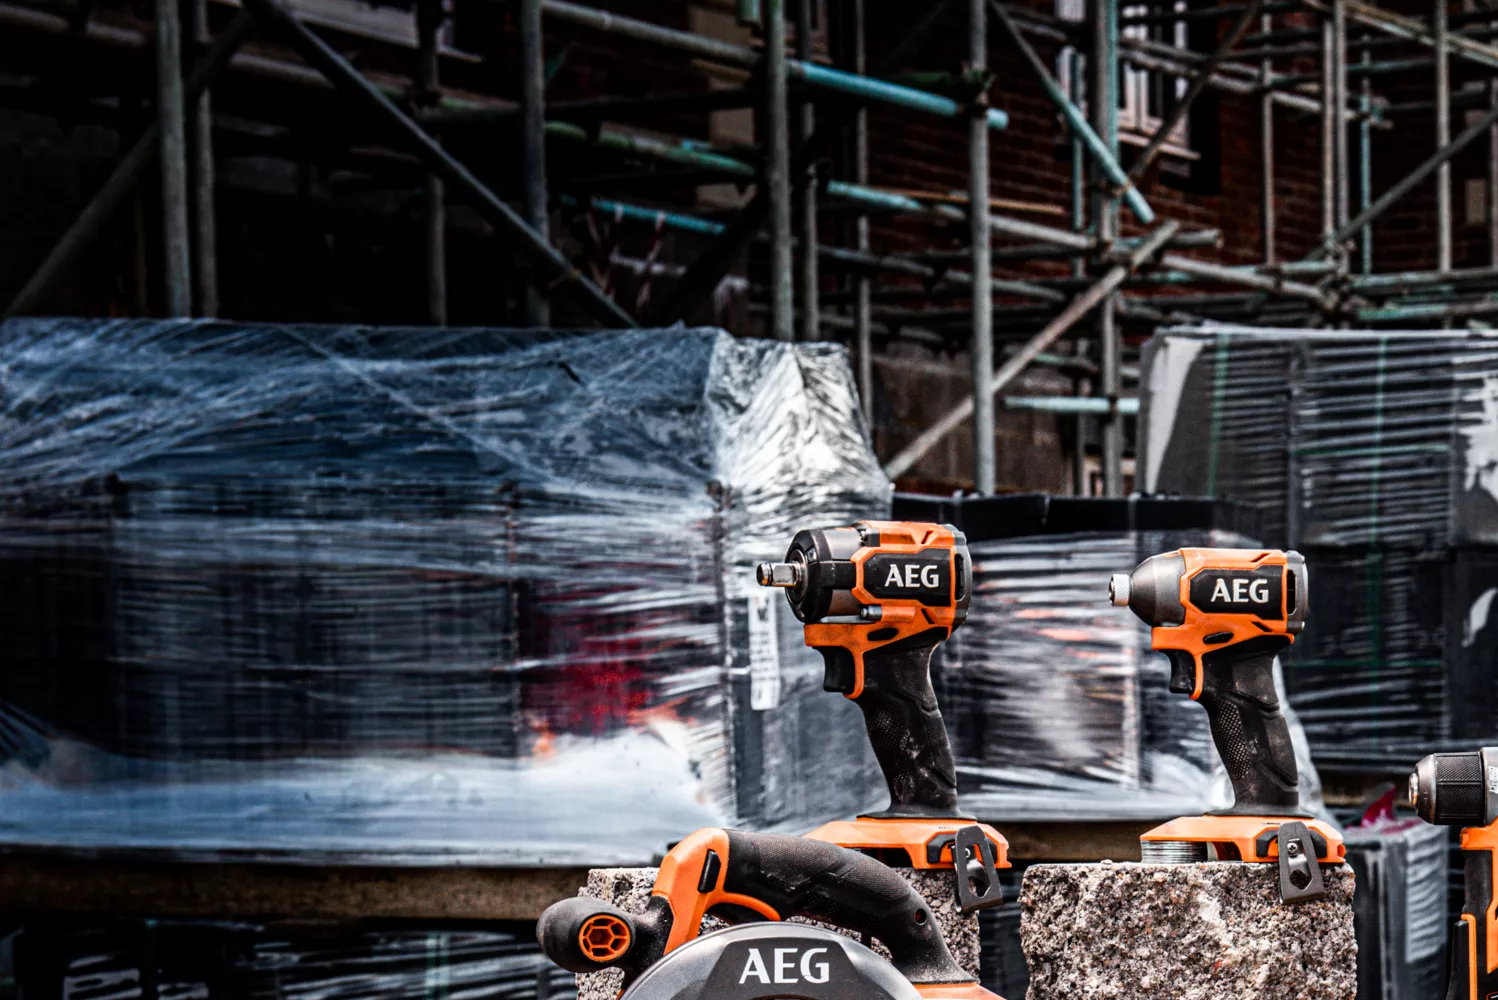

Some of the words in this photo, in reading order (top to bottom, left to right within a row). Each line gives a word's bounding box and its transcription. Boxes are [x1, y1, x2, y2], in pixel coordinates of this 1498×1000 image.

[884, 563, 939, 588] AEG
[1210, 577, 1269, 603] AEG
[738, 947, 830, 985] AEG
